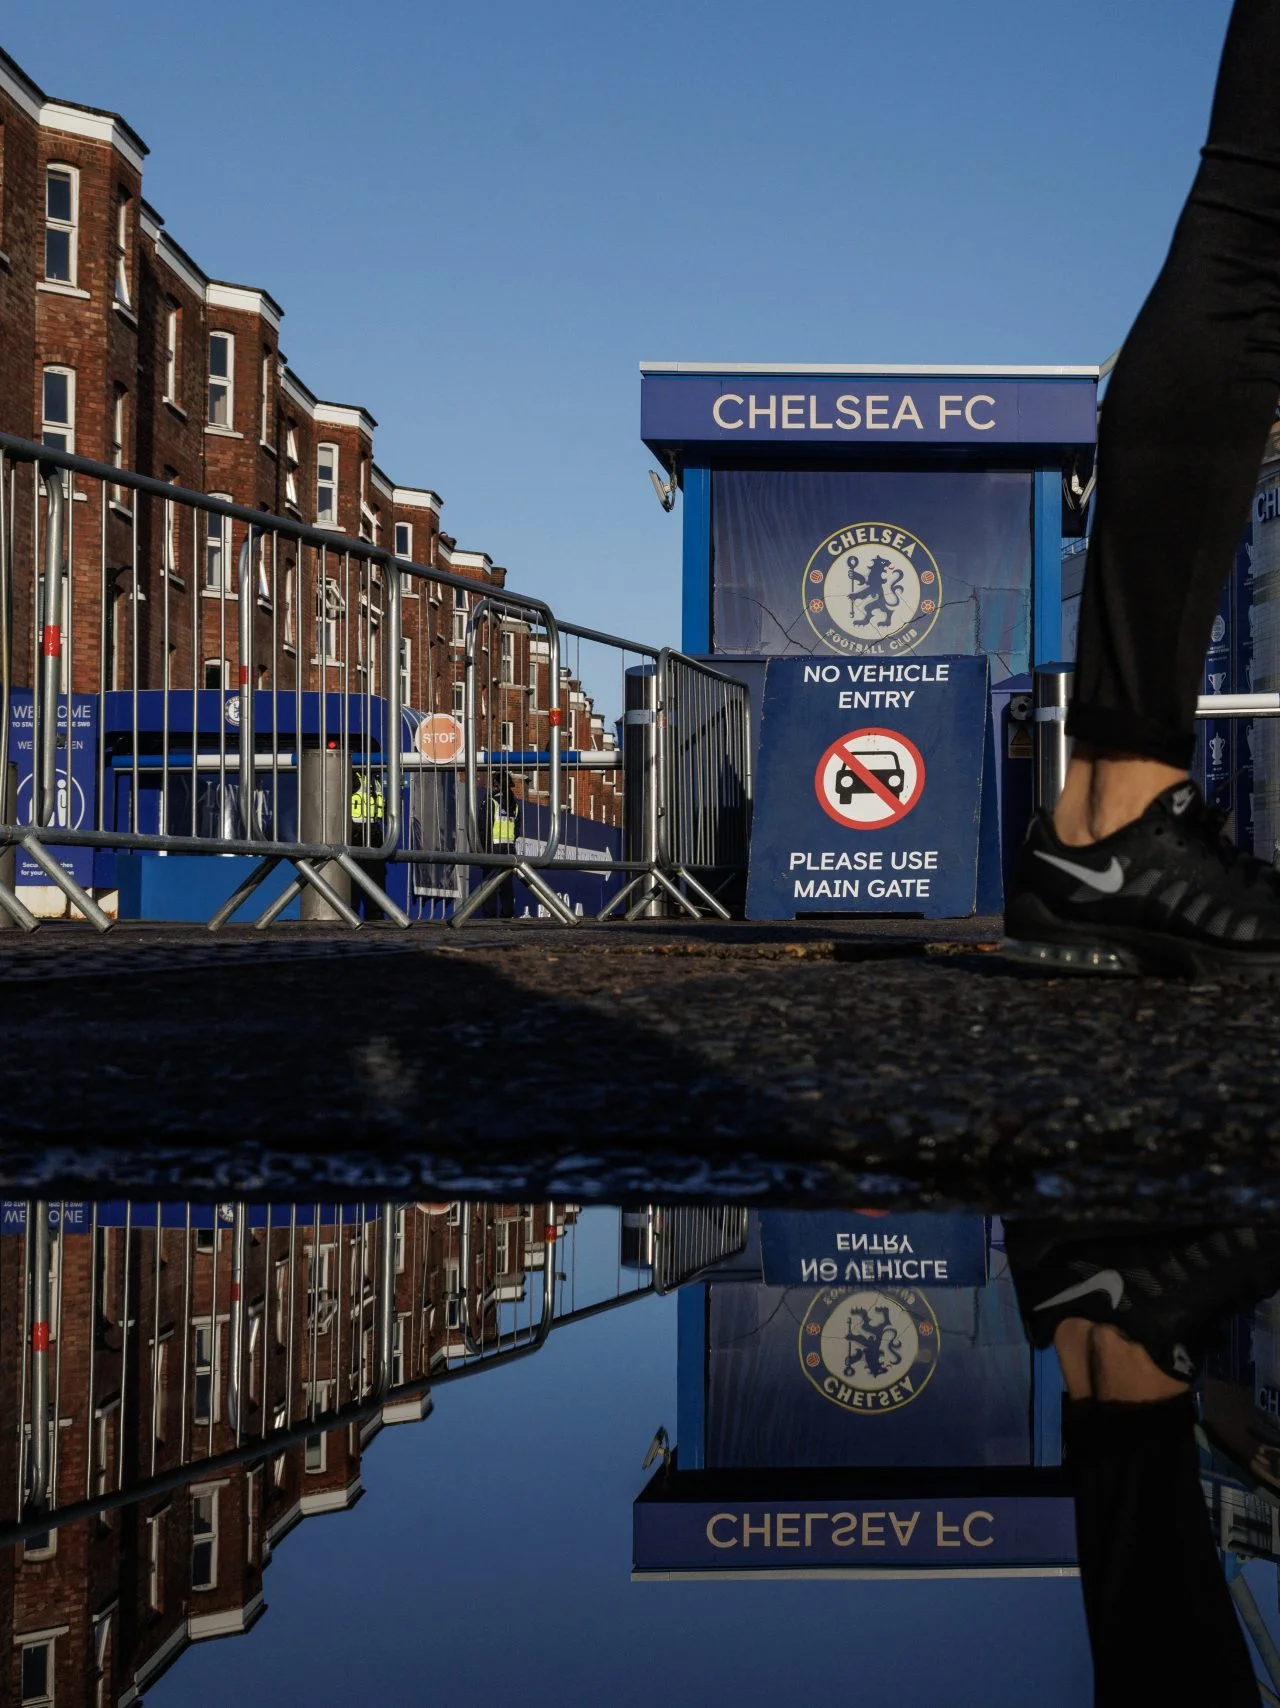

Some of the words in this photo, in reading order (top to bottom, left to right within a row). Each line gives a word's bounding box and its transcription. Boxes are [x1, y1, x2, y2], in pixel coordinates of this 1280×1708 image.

[712, 394, 924, 430] CHELSEA
[939, 394, 996, 430] FC
[827, 527, 917, 559] CHELSEA
[825, 628, 885, 654] FOOTBALL
[889, 628, 918, 651] CLUB
[803, 665, 840, 683] NO
[847, 664, 949, 683] VEHICLE
[838, 690, 916, 709] ENTRY
[12, 705, 92, 719] WEOME
[422, 732, 456, 744] STOP
[789, 852, 883, 871] PLEASE
[891, 851, 938, 870] USE
[793, 879, 860, 898] MAIN
[867, 879, 930, 898] GATE
